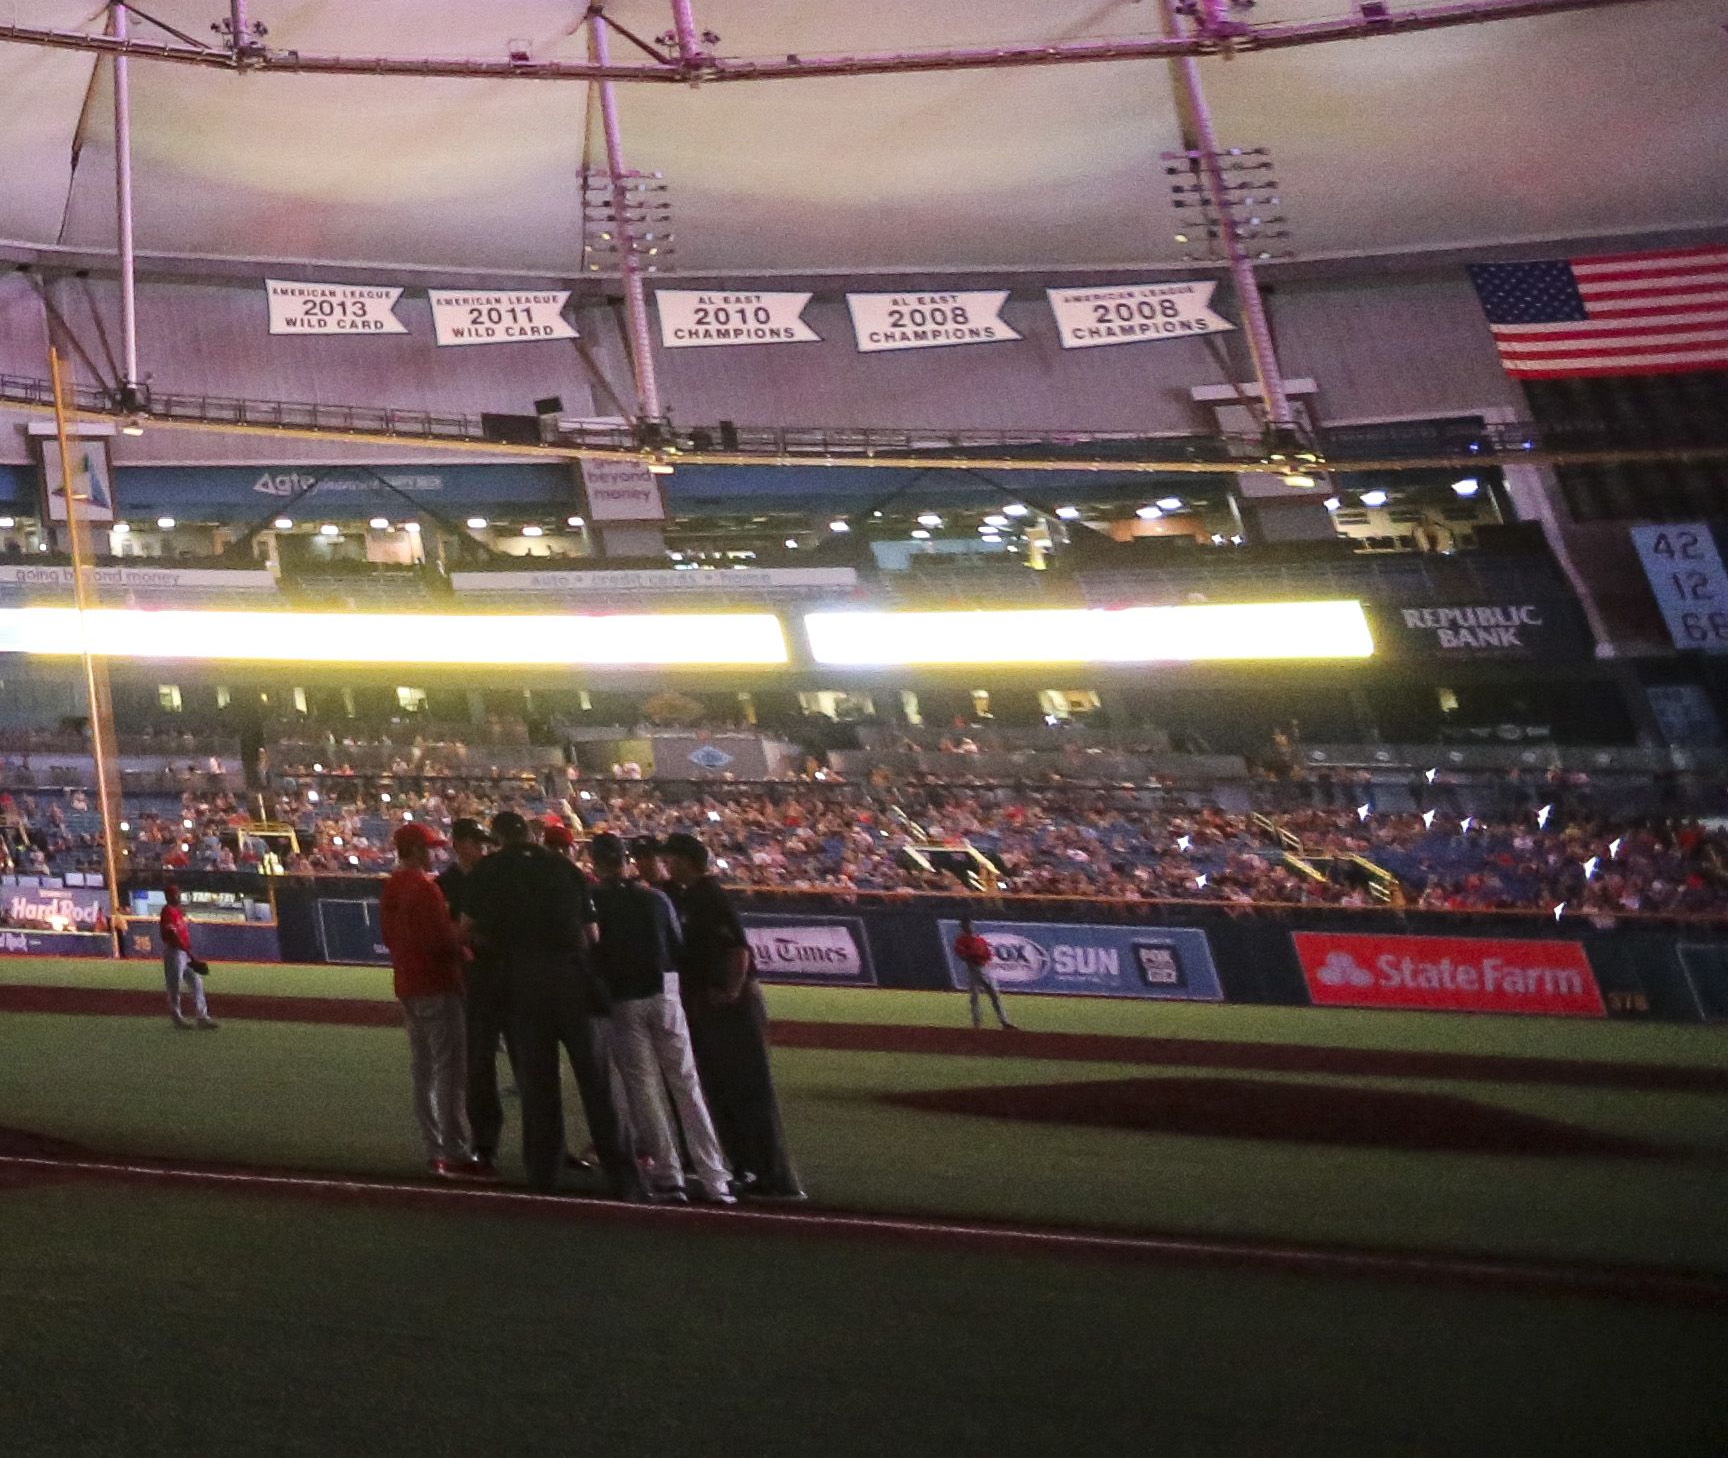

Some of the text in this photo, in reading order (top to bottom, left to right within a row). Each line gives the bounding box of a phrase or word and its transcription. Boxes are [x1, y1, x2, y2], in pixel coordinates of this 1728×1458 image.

[271, 287, 392, 300] AMERICAN LEAGUE
[435, 294, 560, 306] AMERICAN LEAGUE
[697, 295, 762, 305] AL EAST
[891, 295, 959, 307] AL EAST
[302, 299, 368, 317] 2013
[468, 307, 535, 325] 2011
[694, 306, 771, 326] 2010
[887, 306, 970, 328] 2008
[1093, 298, 1179, 324] 2008
[285, 316, 385, 330] WILD CARD
[452, 325, 555, 338] WILD CARD
[1071, 317, 1210, 341] CHAMPIONS
[674, 327, 795, 340] CHAMPIONS
[869, 327, 996, 344] CHAMPIONS
[1653, 531, 1705, 560] 42
[15, 568, 181, 587] going bond money
[1672, 571, 1714, 601] 12
[1401, 605, 1542, 629] REPUBLIC
[1437, 625, 1524, 649] BANK
[11, 896, 59, 922] Hard
[773, 937, 848, 964] Times
[994, 943, 1032, 965] OX
[1052, 944, 1121, 976] SUN
